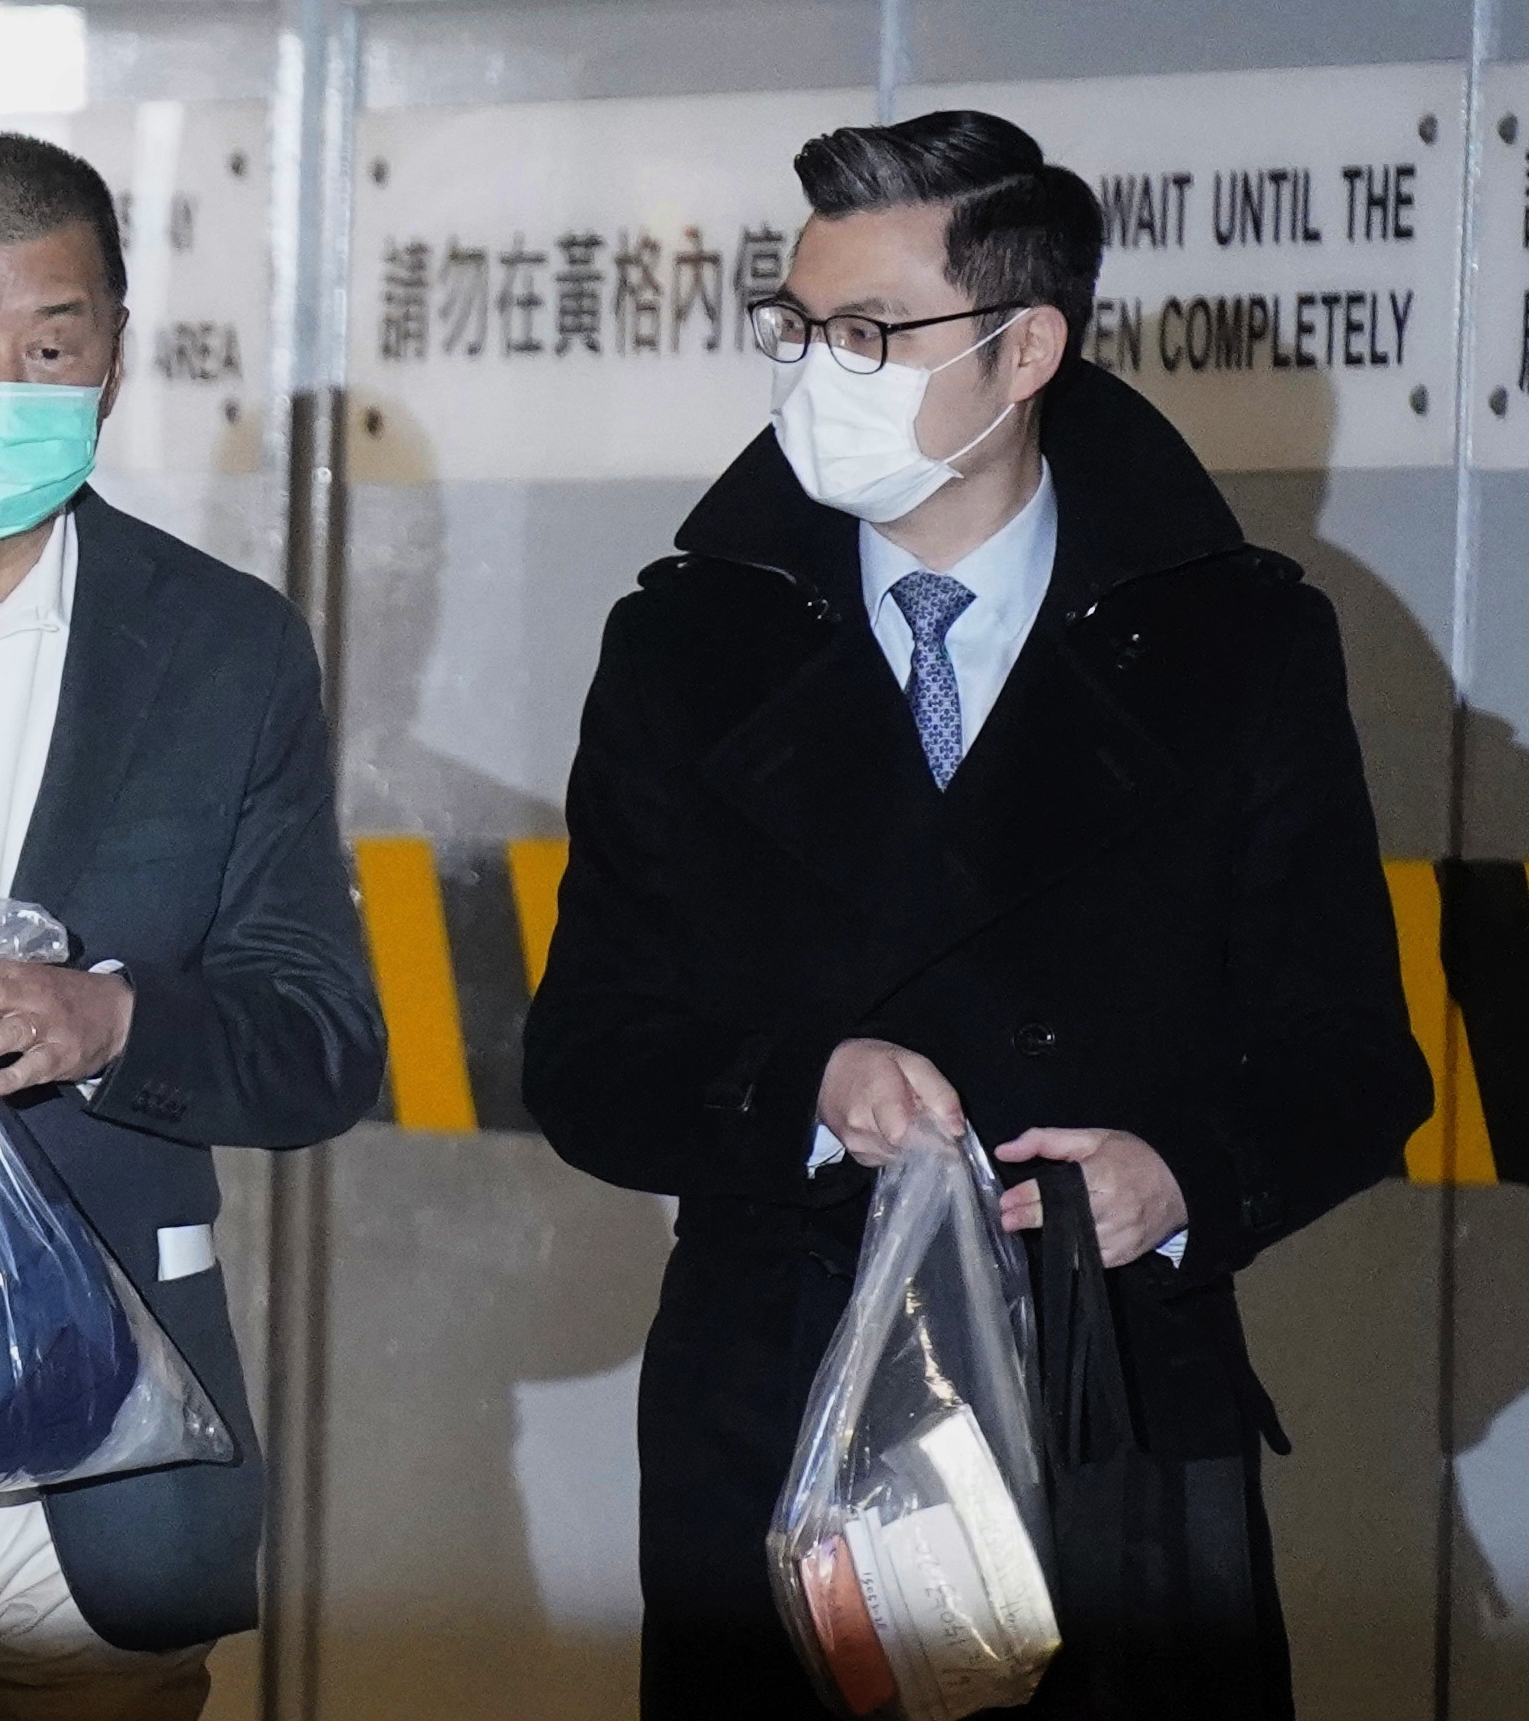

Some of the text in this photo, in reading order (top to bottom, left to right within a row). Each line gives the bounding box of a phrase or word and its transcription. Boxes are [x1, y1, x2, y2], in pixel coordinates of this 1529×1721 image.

[1099, 161, 1417, 250] WAIT UNTIL THE
[1158, 288, 1415, 373] COMPLETELY
